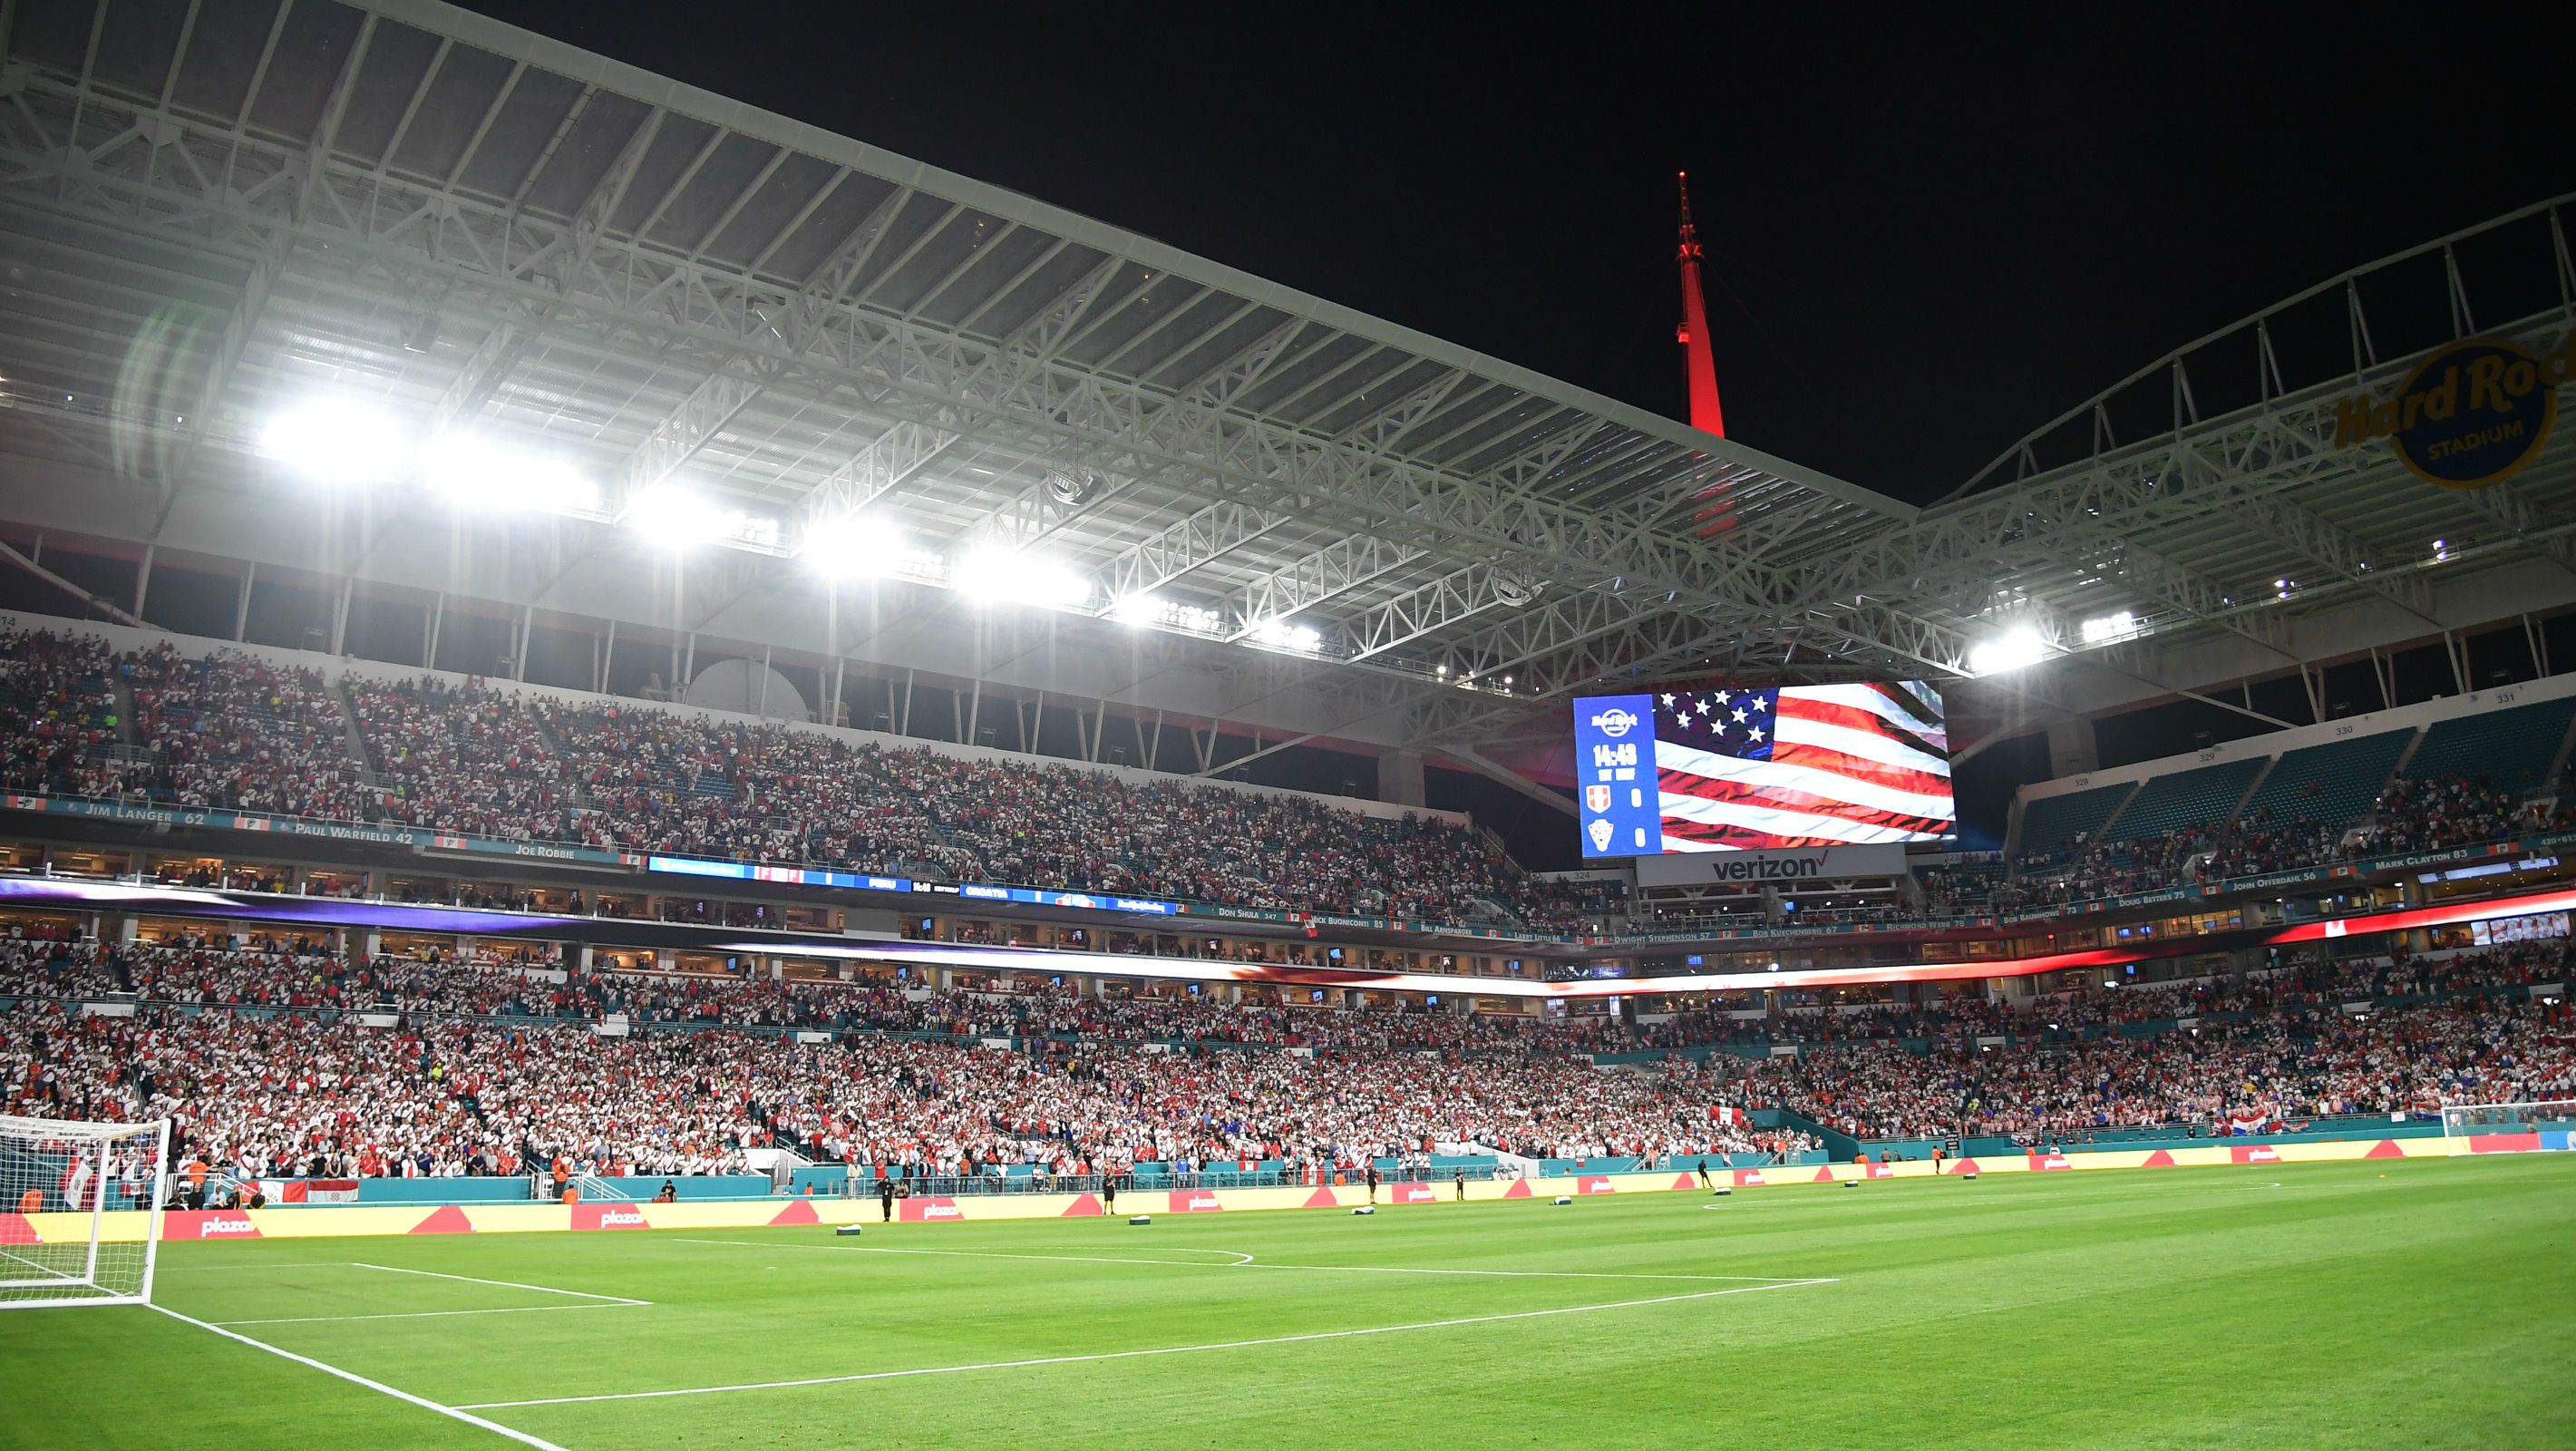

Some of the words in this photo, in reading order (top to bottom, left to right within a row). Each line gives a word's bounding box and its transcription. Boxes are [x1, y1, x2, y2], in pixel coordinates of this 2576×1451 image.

[2331, 365, 2459, 451] Hard
[2427, 420, 2524, 461] STADIUM
[2497, 694, 2515, 704] 331
[2336, 726, 2353, 735] 330
[2200, 753, 2215, 762] 329
[85, 803, 110, 816] JIM
[116, 807, 172, 822] LANGER
[185, 813, 204, 824] 62
[295, 823, 326, 836] PAUL
[330, 826, 390, 842] WARFIELD
[395, 833, 413, 844] 42
[515, 844, 536, 856] JOE
[538, 846, 574, 859] ROBBIE
[2376, 860, 2404, 871] MARK
[2406, 853, 2451, 867] CLAYTON
[2454, 849, 2468, 859] 83
[1713, 855, 1817, 881] verizon
[2232, 881, 2255, 891] JOHN
[2257, 875, 2301, 888] OFFERDAHL
[2303, 872, 2316, 881] 56
[966, 886, 1008, 899] CROATIA
[2119, 898, 2141, 907] DOUG
[2143, 893, 2172, 904] BETTERS
[2174, 891, 2185, 900] 75
[1219, 907, 1236, 917] DON
[1238, 910, 1259, 919] SHULA
[2020, 910, 2060, 921] BAUMHOWE
[2066, 907, 2077, 915] 73
[1328, 917, 1369, 927] BUONICONTI
[1374, 920, 1384, 929] 85
[1421, 924, 1433, 932] BILL
[1825, 926, 1837, 934] 67
[1887, 922, 1927, 930] RICHMOND
[1514, 931, 1532, 940] LARRY
[1614, 936, 1646, 944] DWIGHT
[1648, 933, 1697, 942] STEPHENSON
[601, 1210, 642, 1229] plaza
[201, 1217, 249, 1238] plaza
